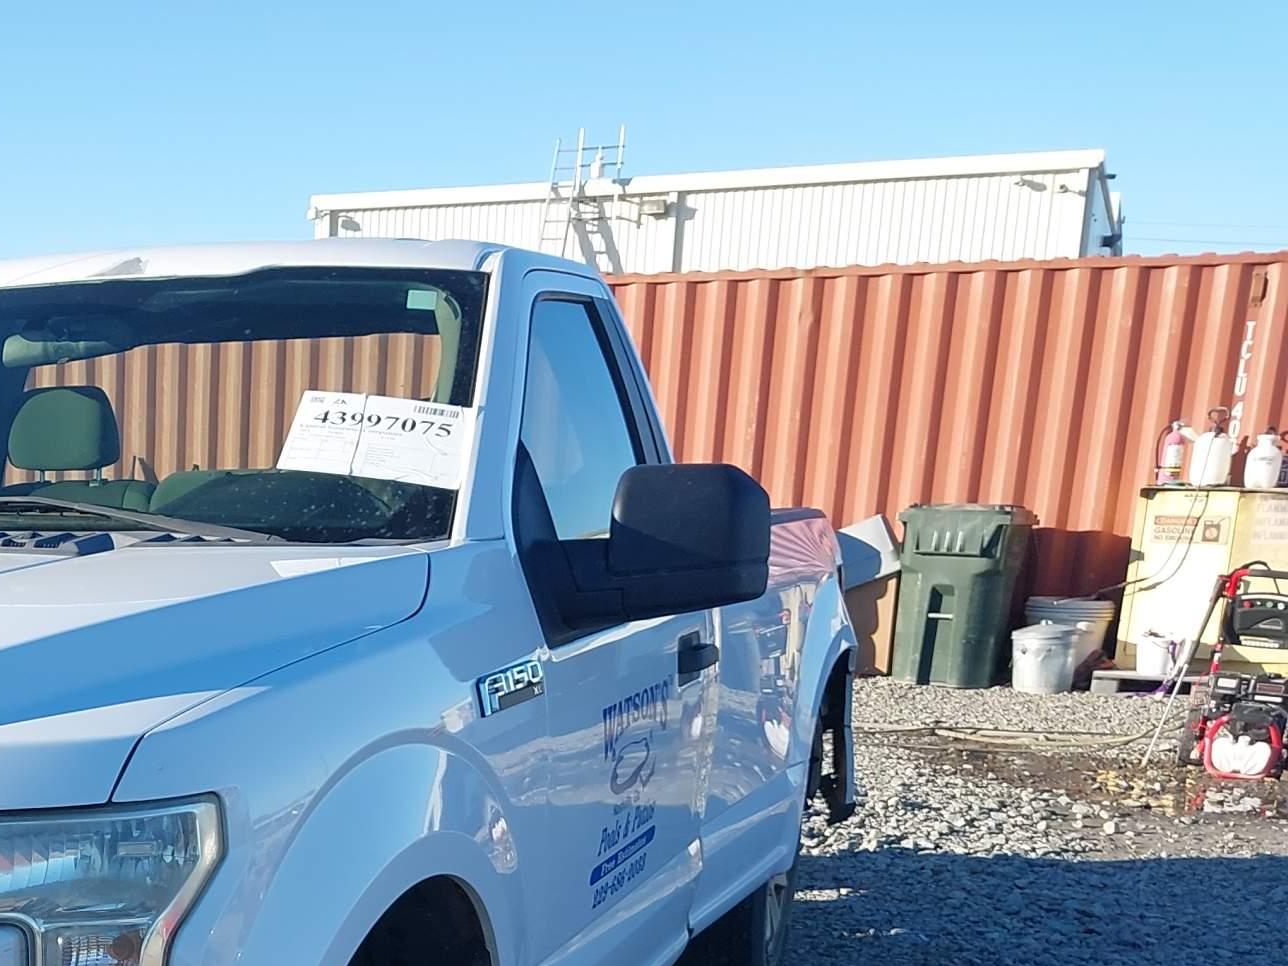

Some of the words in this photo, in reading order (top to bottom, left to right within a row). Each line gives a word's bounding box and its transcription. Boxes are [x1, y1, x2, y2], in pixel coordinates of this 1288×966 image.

[1234, 320, 1256, 397] TCLU
[314, 410, 454, 439] 43997075
[1154, 526, 1194, 535] GASOLIN
